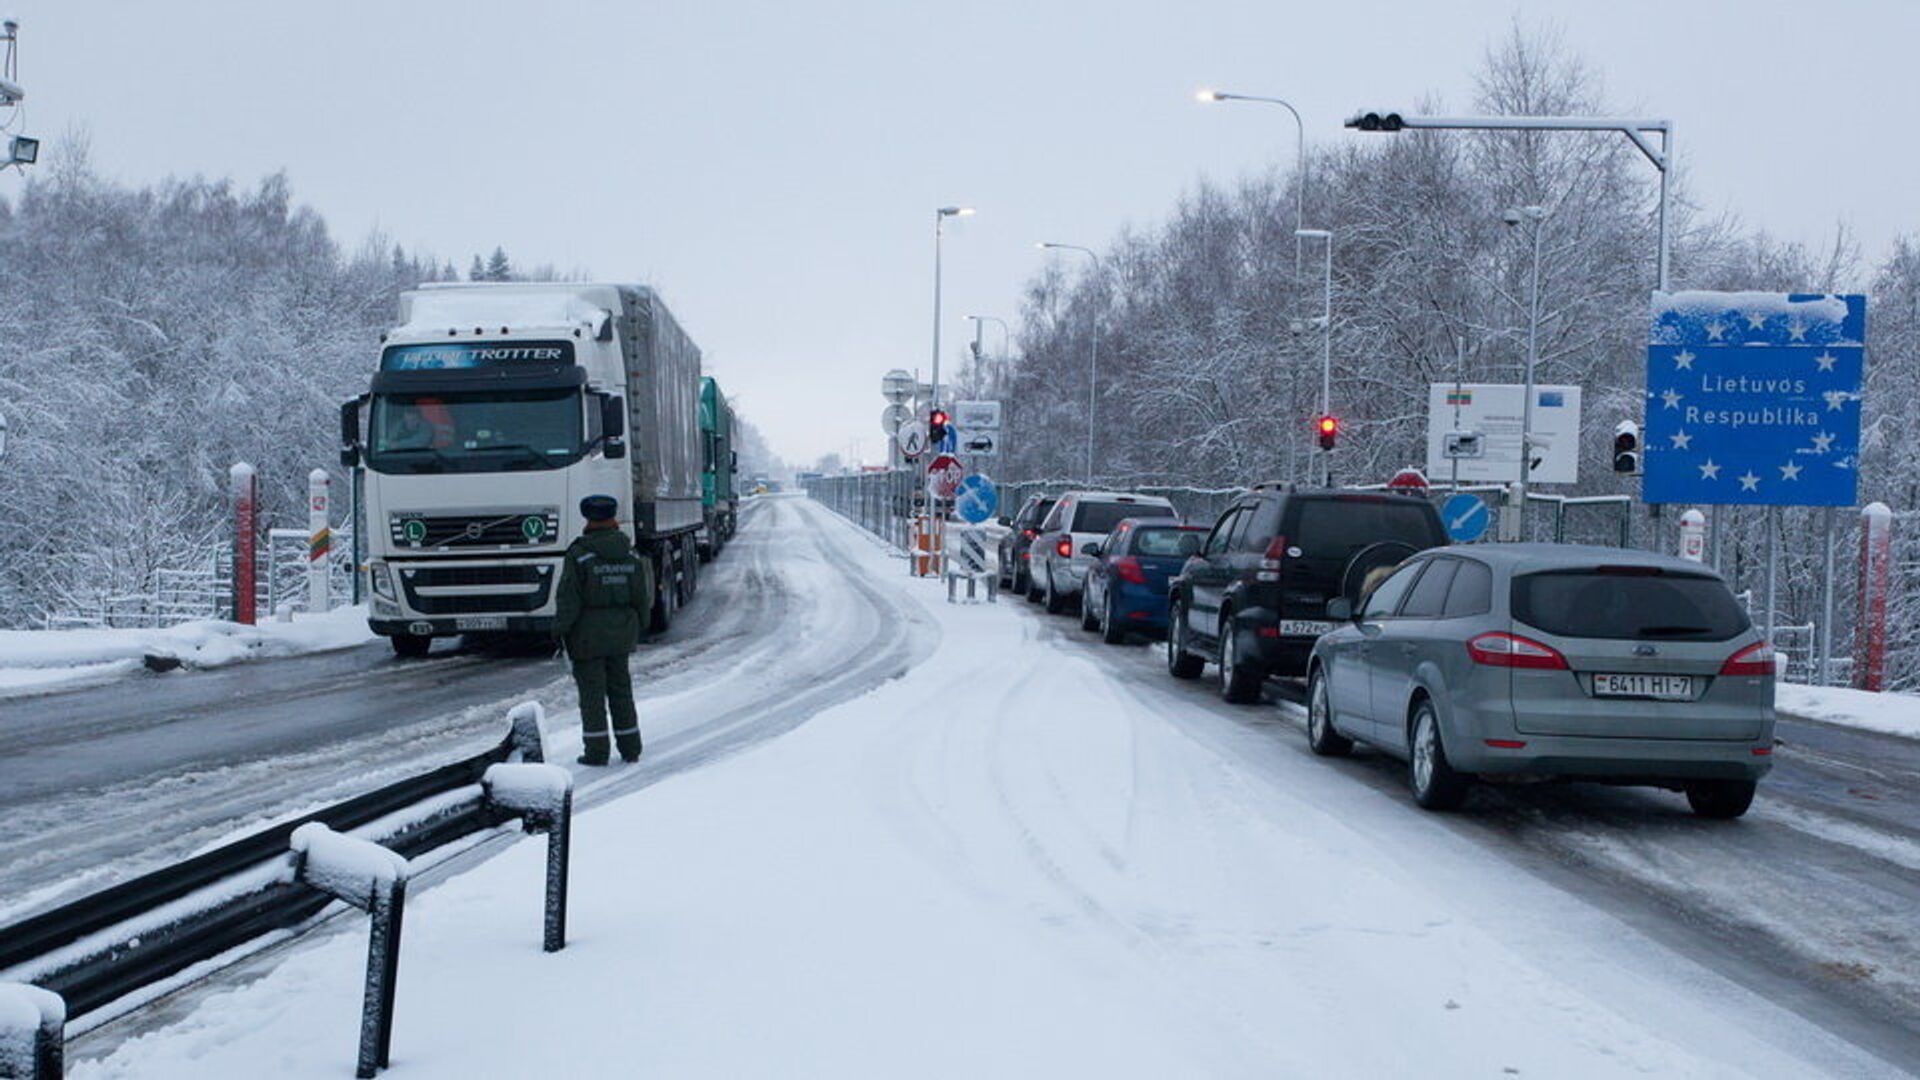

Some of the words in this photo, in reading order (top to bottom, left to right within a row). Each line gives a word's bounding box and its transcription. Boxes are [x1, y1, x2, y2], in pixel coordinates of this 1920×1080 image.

[1702, 373, 1806, 393] Lietuvos
[1686, 405, 1818, 428] Respublika
[1609, 675, 1646, 692] 6411
[1651, 676, 1690, 693] HI-7
